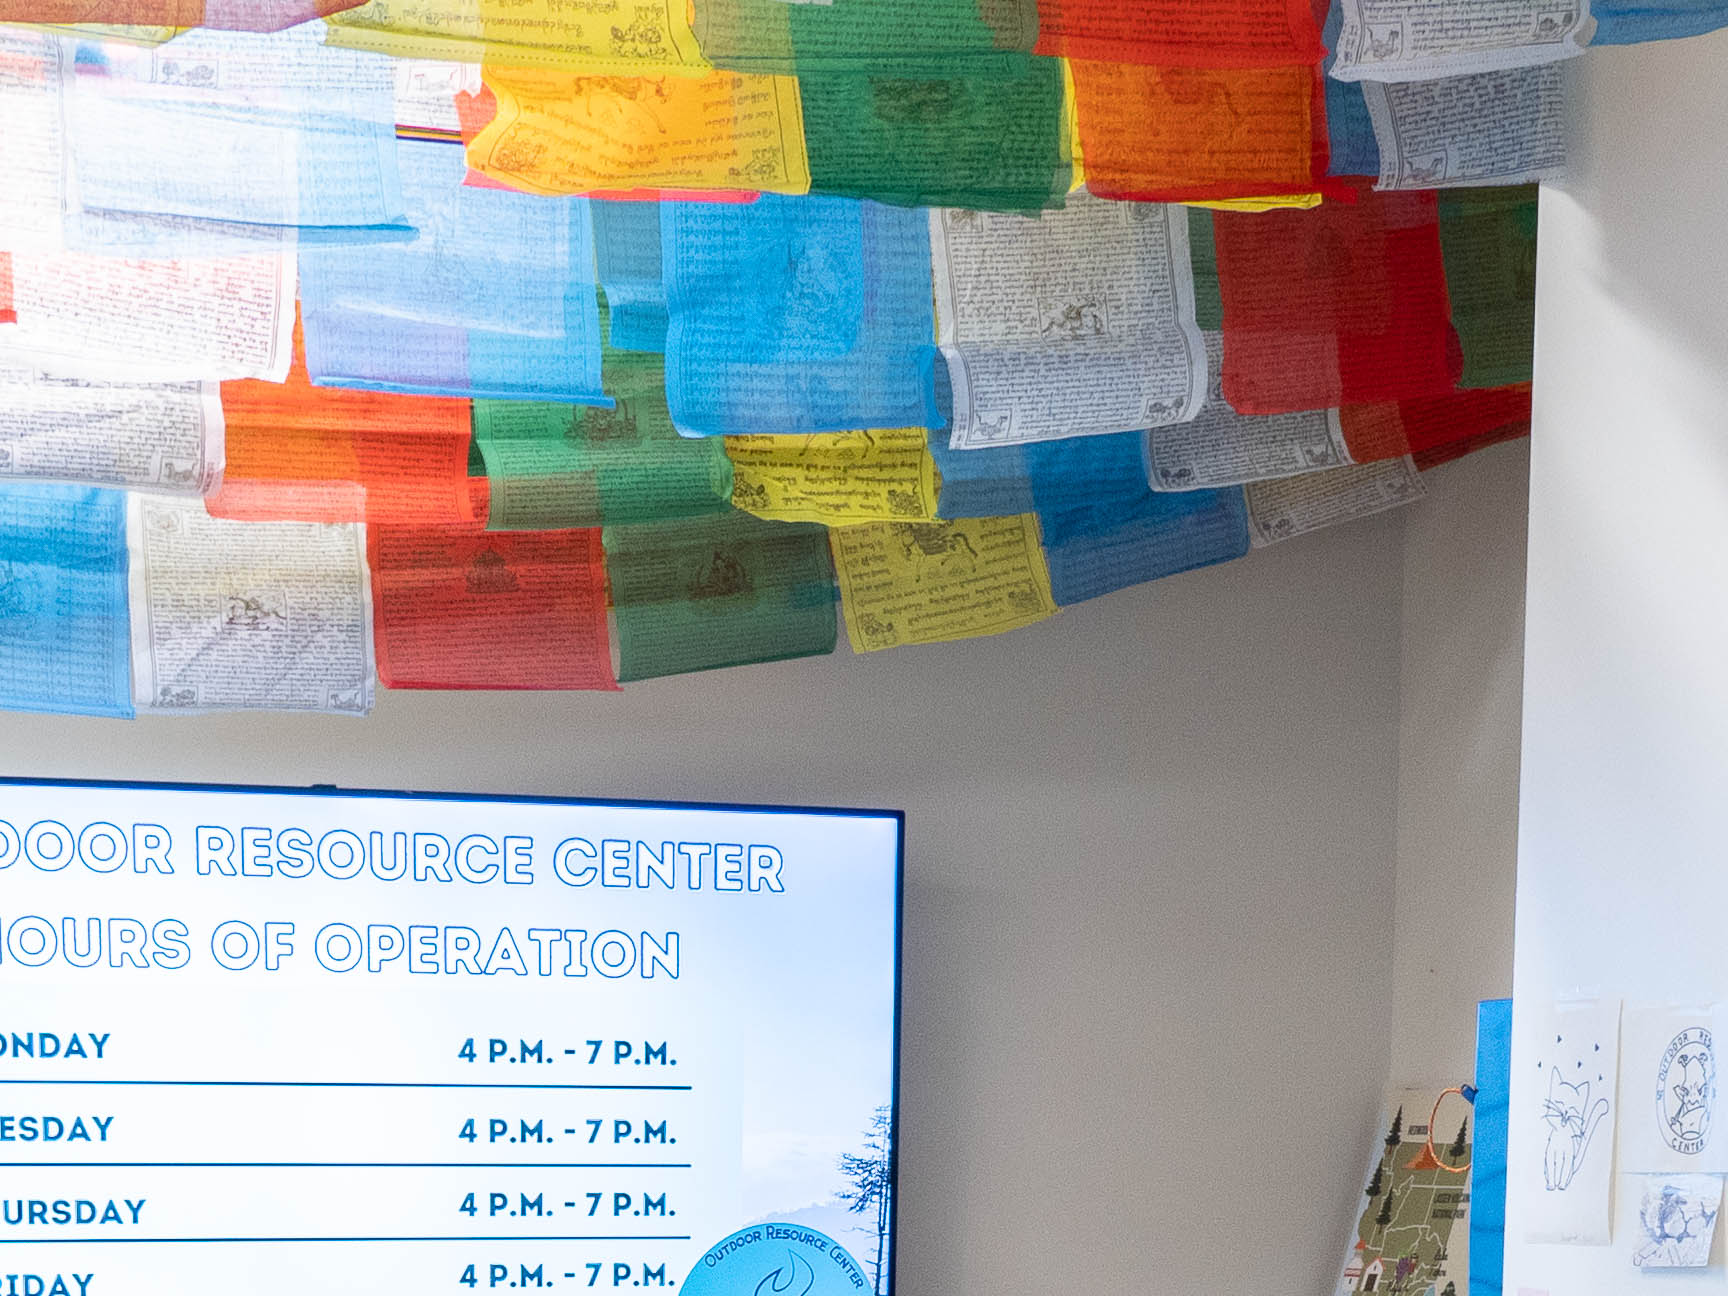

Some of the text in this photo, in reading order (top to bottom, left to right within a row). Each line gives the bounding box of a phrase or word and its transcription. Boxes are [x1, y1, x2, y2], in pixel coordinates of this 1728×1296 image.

[195, 825, 534, 885] RESOURCE
[553, 837, 785, 893] CENTER
[211, 920, 295, 971] OF
[315, 922, 680, 979] OPERATION
[458, 1038, 477, 1063] 4
[489, 1039, 553, 1064] P.M.
[586, 1040, 603, 1064] 7
[614, 1040, 677, 1066] P.M.
[458, 1118, 477, 1143] 4
[489, 1118, 553, 1144] P.M.
[586, 1119, 603, 1144] 7
[614, 1119, 677, 1145] P.M.
[459, 1192, 477, 1217] 4
[489, 1192, 553, 1217] P.M.
[586, 1192, 603, 1217] 7
[614, 1192, 676, 1217] P.M.
[704, 1225, 864, 1290] OUTDOOR RESOURCE CENTER
[459, 1264, 478, 1288] 4
[489, 1264, 553, 1288] P.M.
[585, 1263, 603, 1287] 7
[613, 1263, 675, 1287] P.M.
